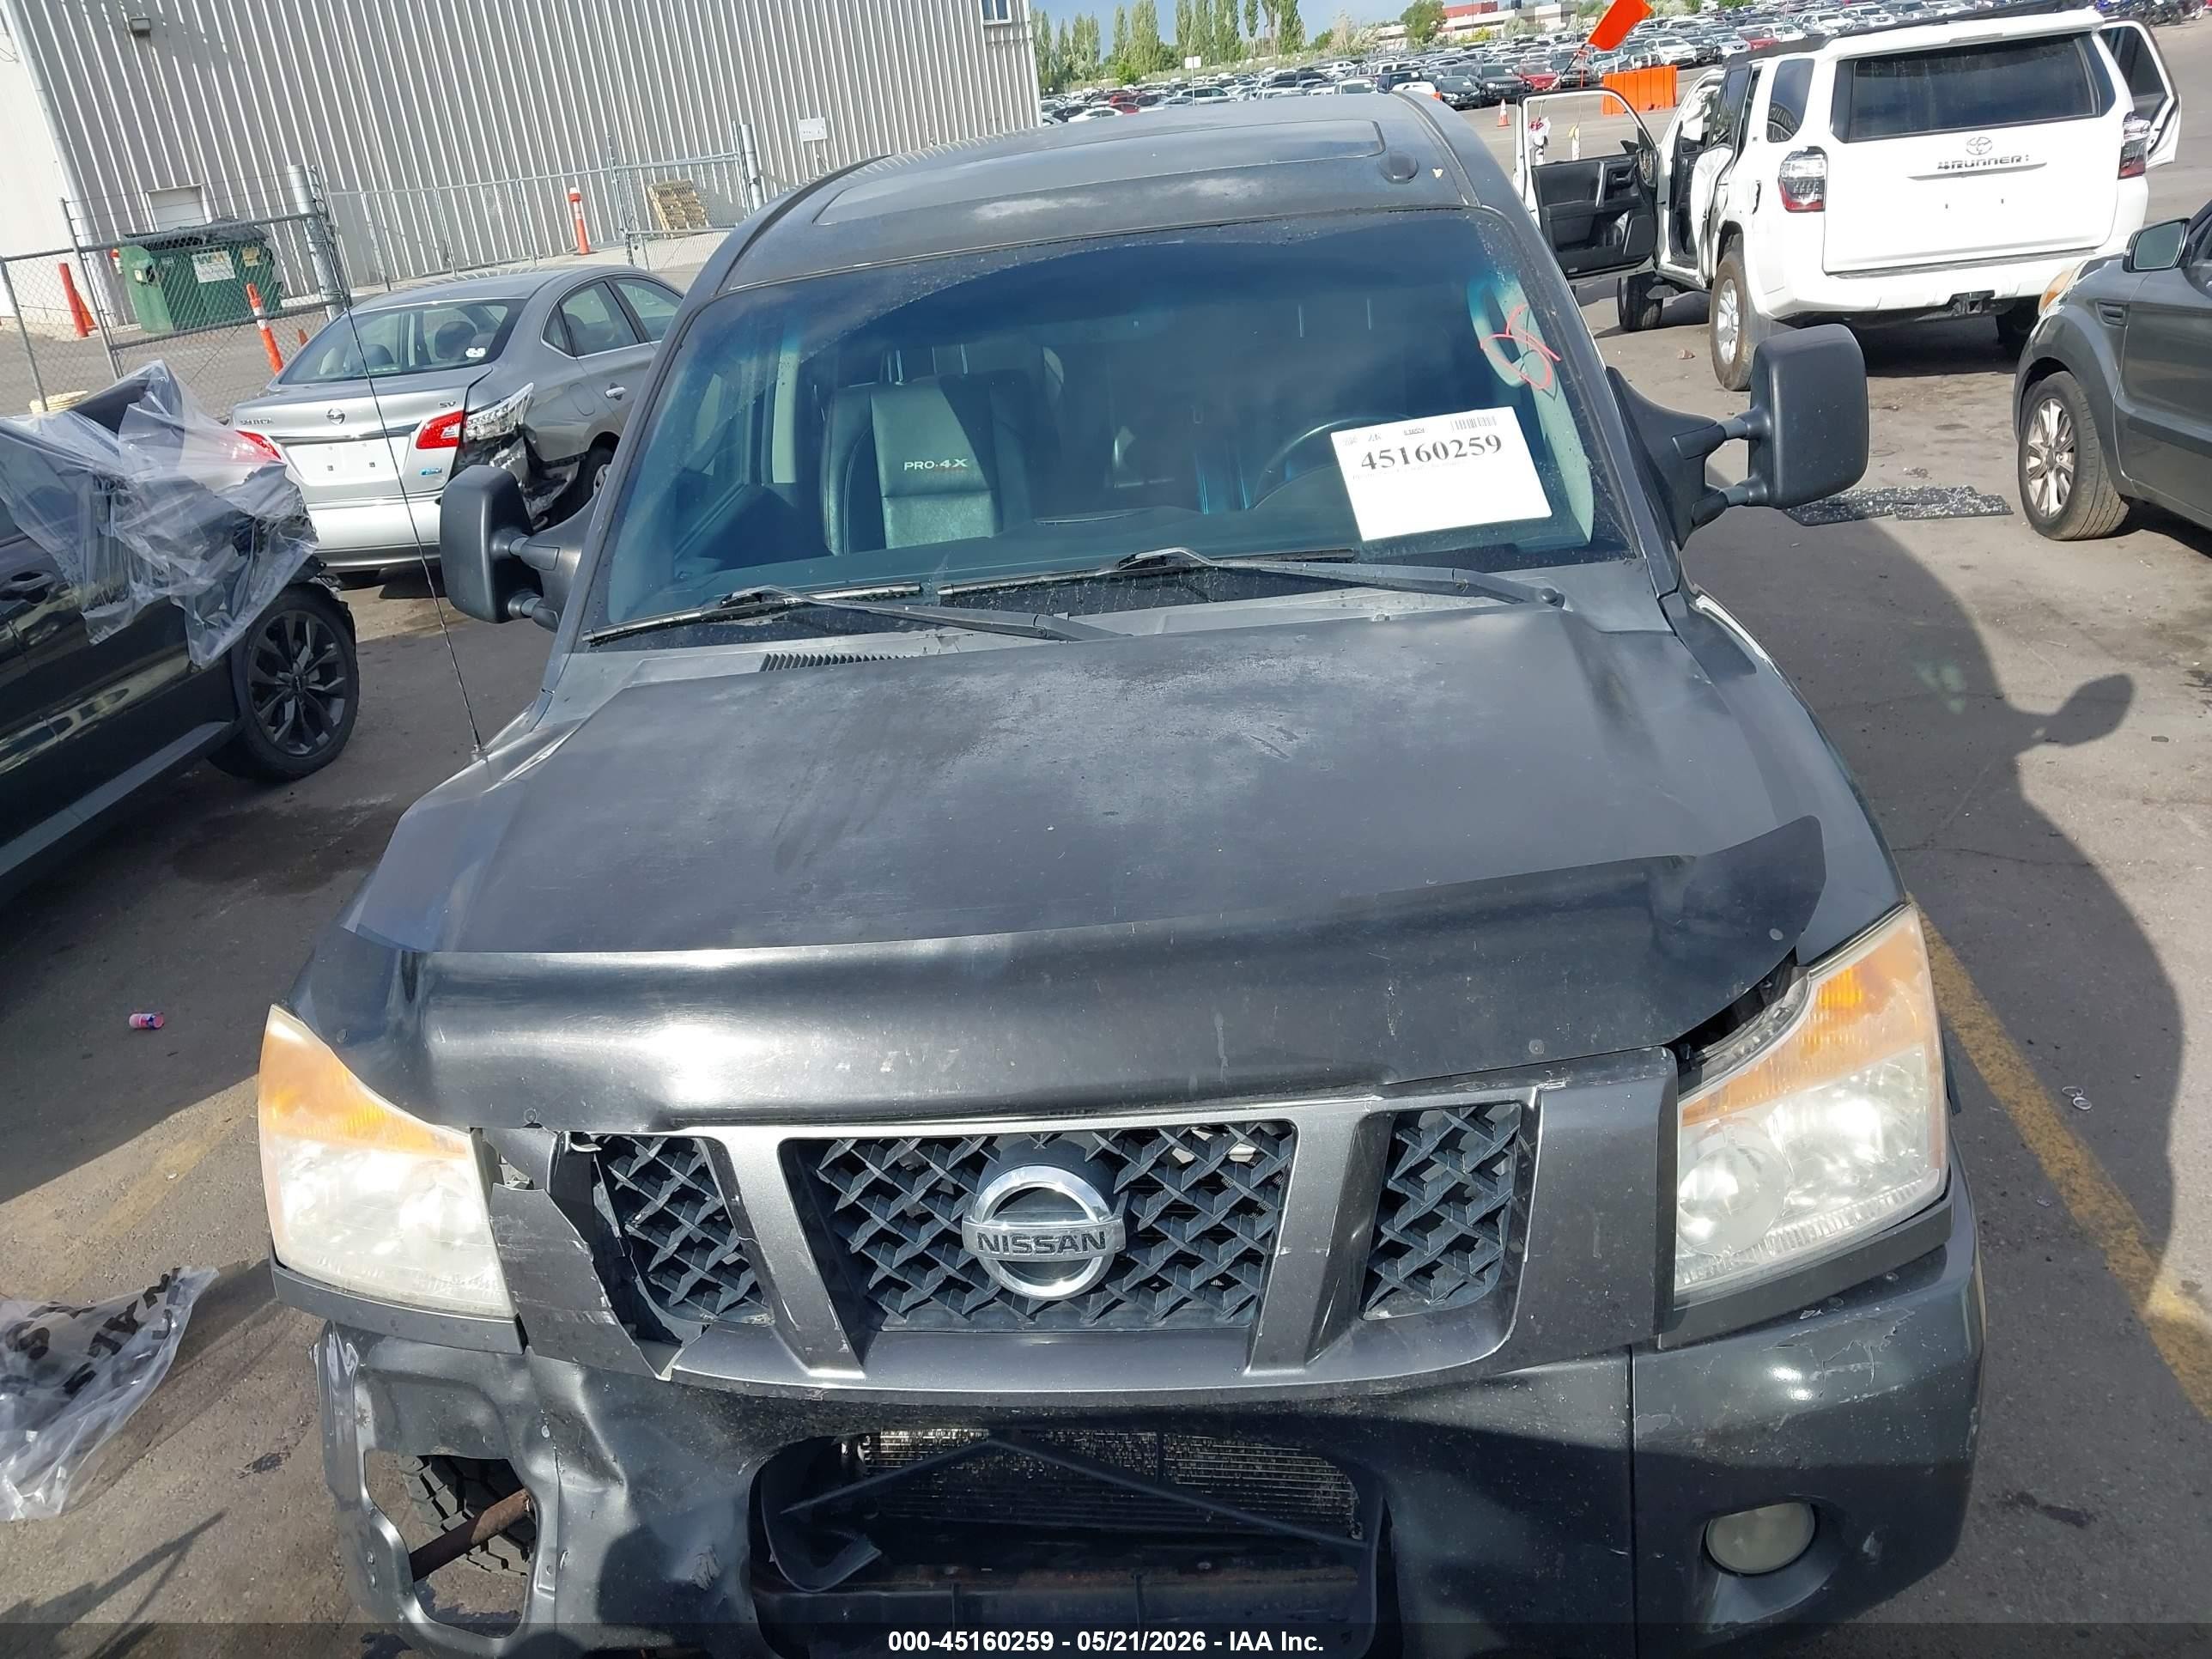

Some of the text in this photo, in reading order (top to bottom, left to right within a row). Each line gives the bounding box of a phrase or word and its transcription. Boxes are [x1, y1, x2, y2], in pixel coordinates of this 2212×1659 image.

[440, 400, 456, 409] SV
[1361, 434, 1502, 471] 45160259
[977, 1231, 1107, 1255] NISSAN
